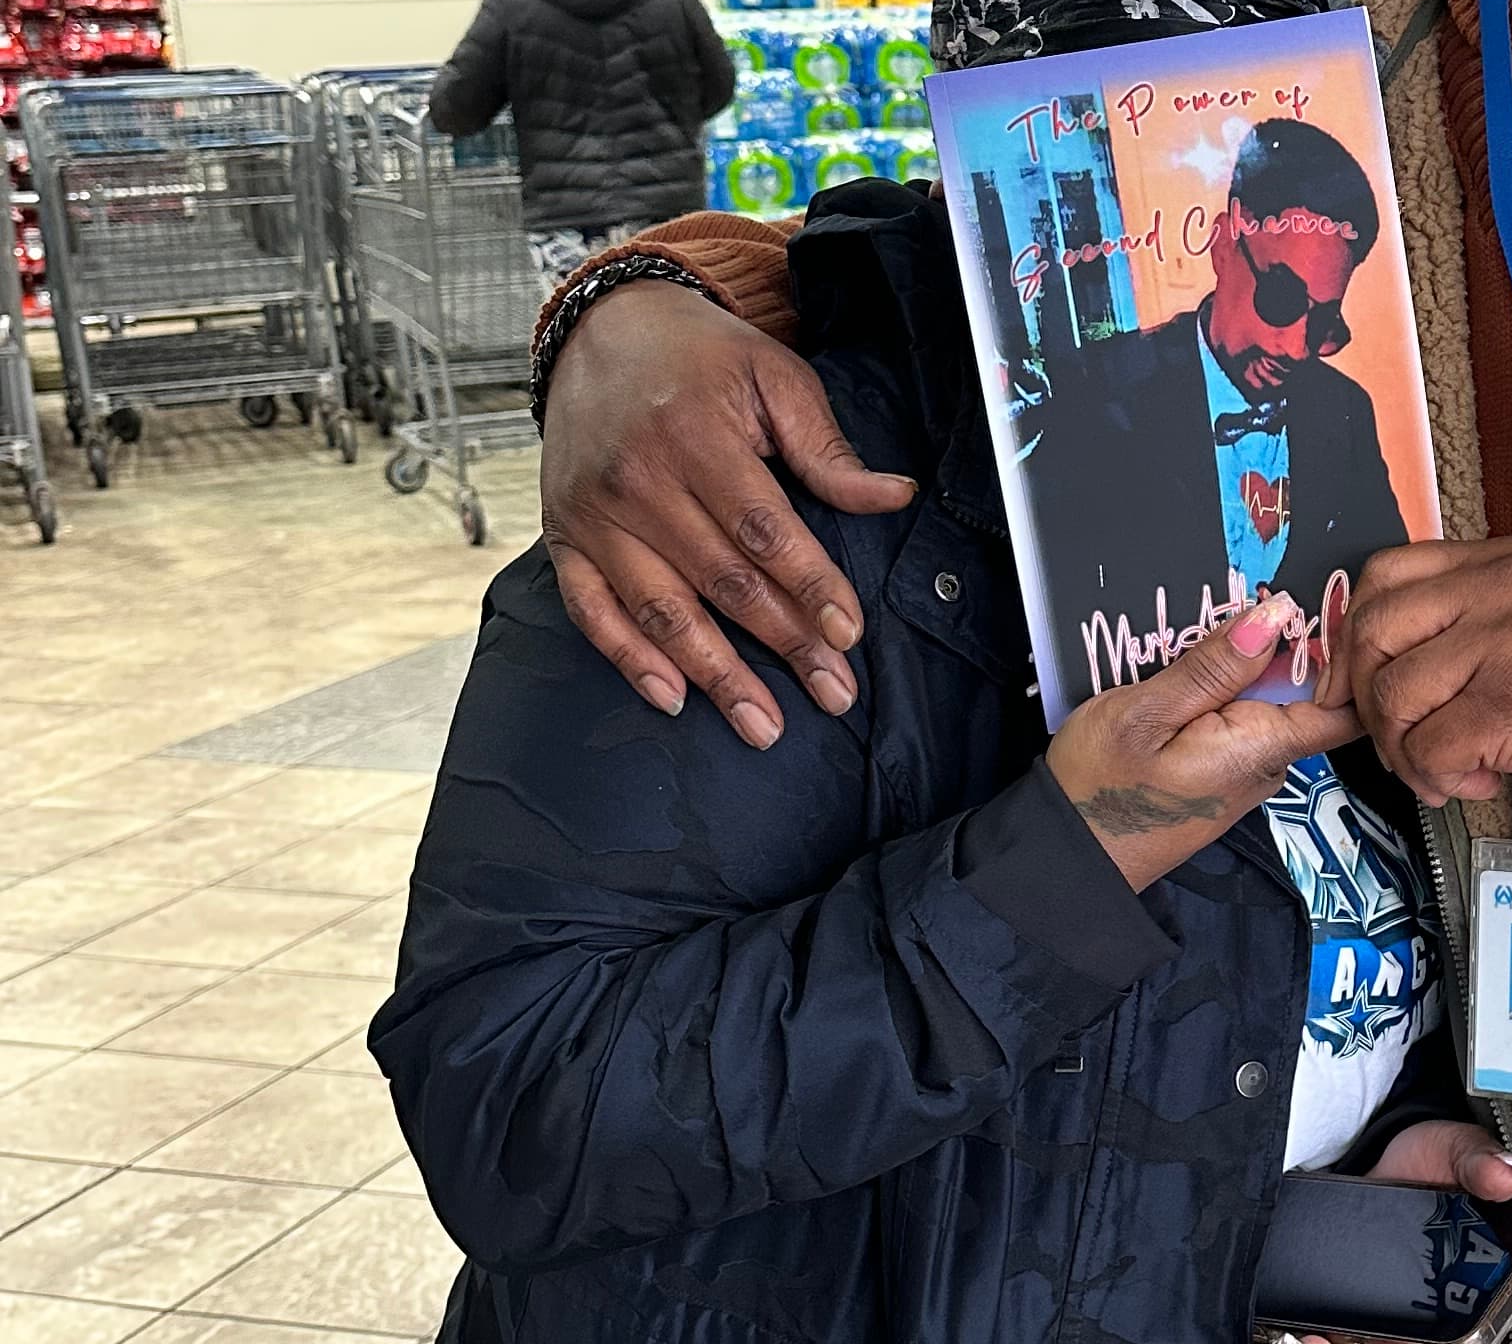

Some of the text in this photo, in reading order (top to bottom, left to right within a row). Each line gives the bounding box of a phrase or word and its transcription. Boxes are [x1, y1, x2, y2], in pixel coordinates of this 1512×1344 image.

[1006, 82, 1310, 164] The Power of
[1011, 196, 1360, 304] Second Chance
